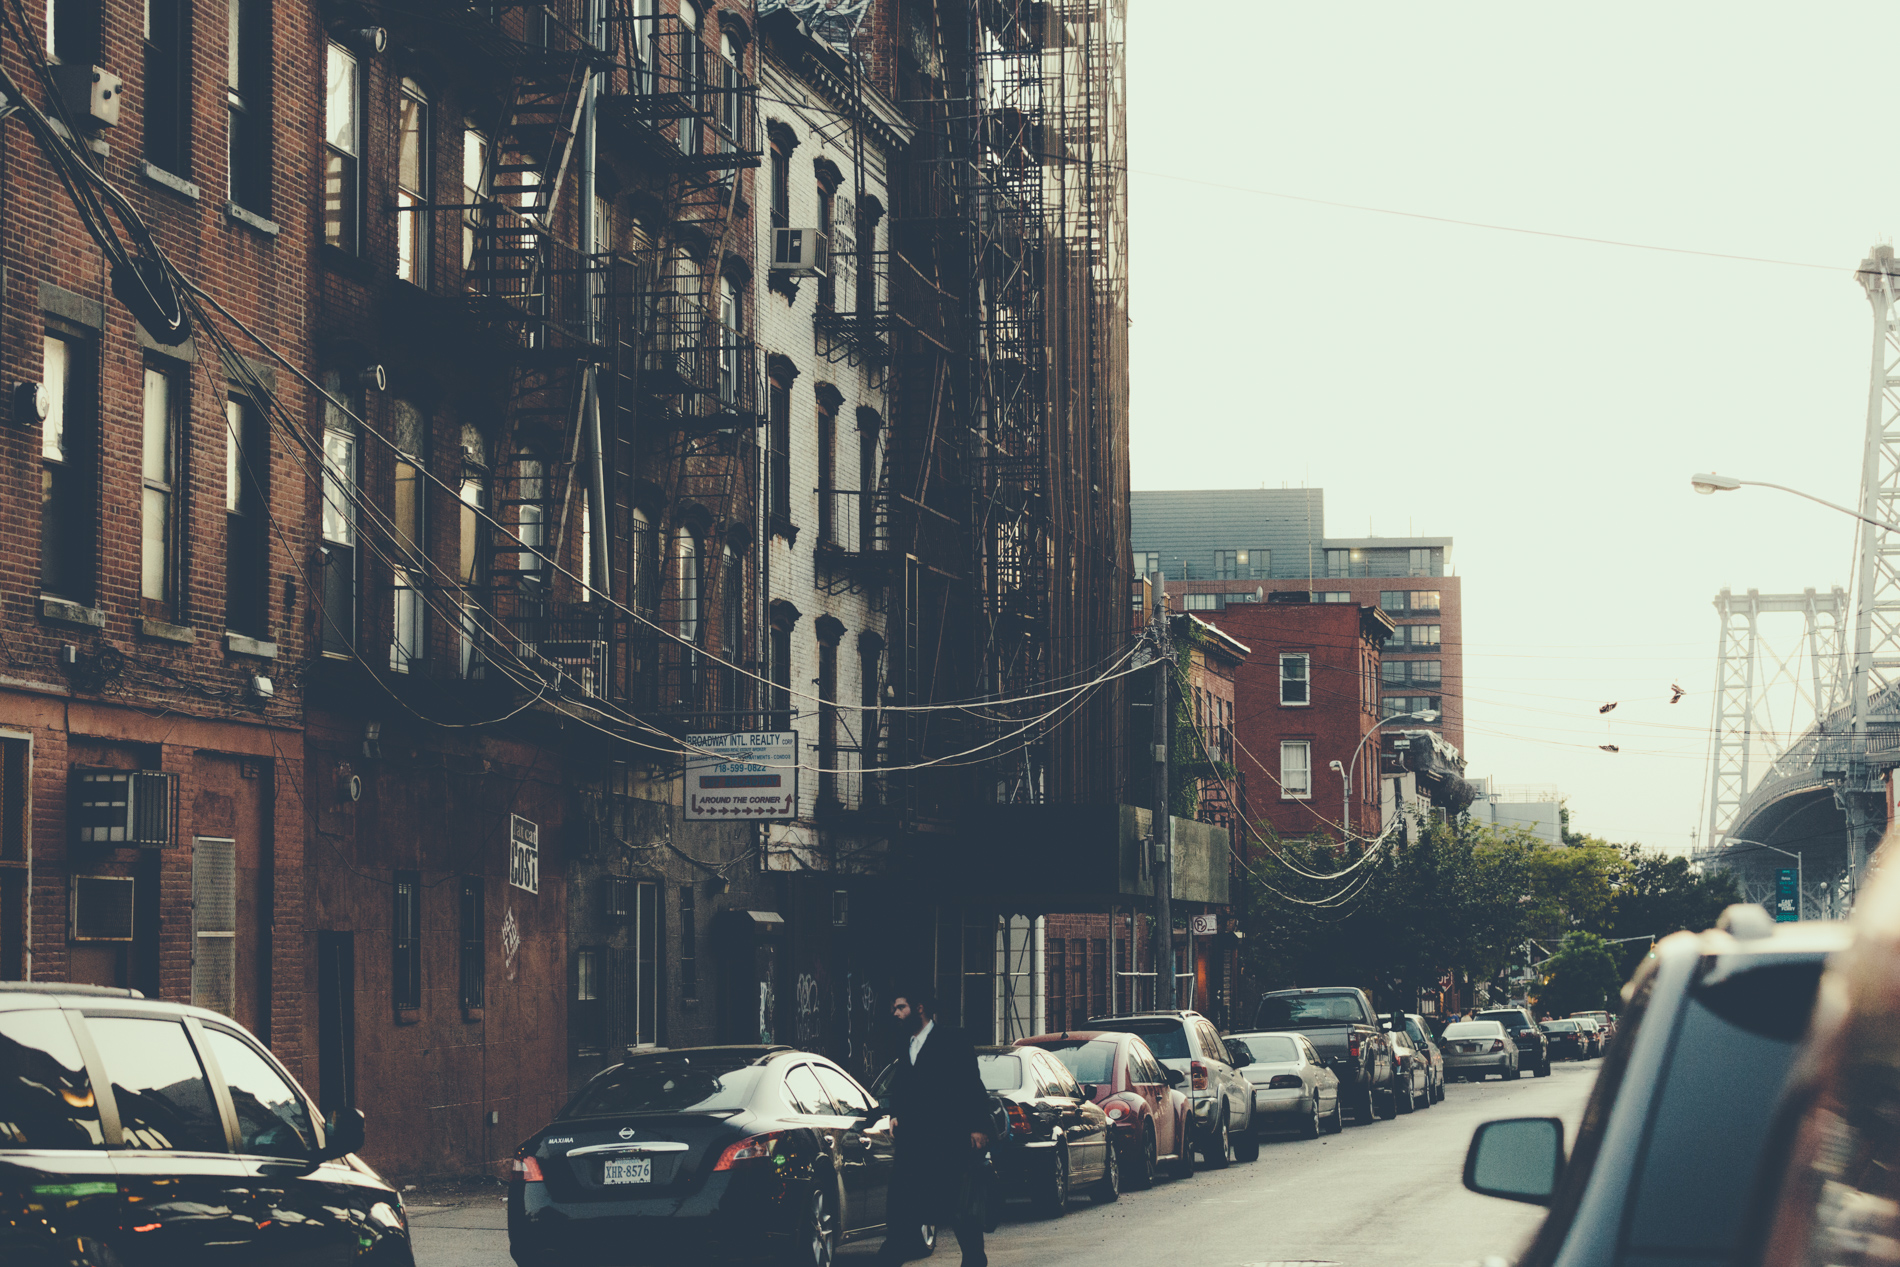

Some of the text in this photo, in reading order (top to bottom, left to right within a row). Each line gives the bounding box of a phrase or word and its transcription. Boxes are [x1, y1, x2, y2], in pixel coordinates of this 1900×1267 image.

[687, 735, 728, 747] BROADWAY
[730, 735, 747, 747] INTL.
[750, 734, 780, 746] REALTY
[714, 763, 766, 773] 718-599-0822
[724, 777, 778, 787] BROADWAY
[700, 796, 781, 804] AROUND THE CORNER
[524, 829, 536, 845] cat
[605, 1164, 650, 1179] XHR-8576
